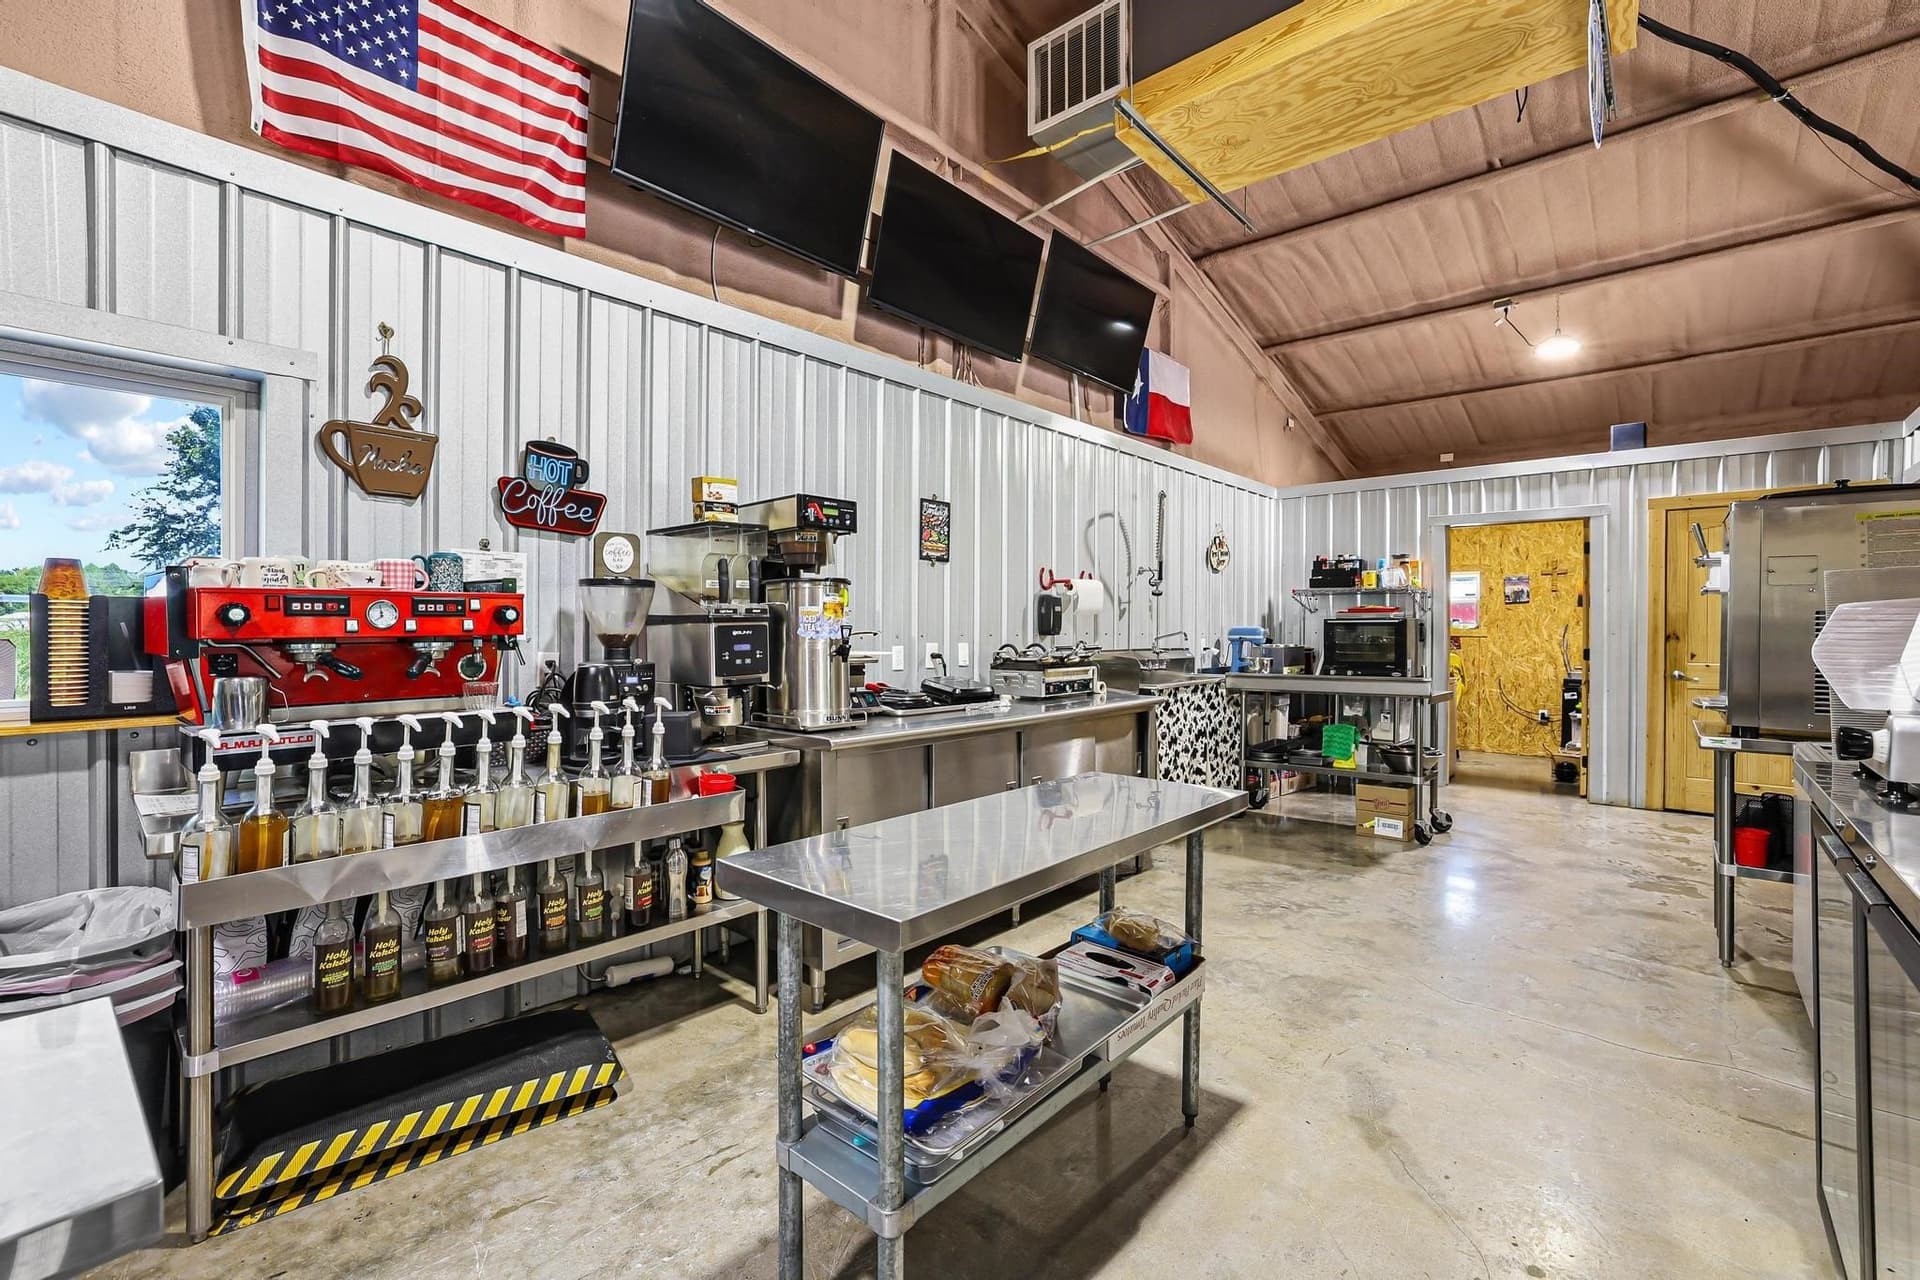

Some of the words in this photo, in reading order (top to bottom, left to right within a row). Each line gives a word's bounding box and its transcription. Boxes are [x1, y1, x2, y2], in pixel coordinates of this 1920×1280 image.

[359, 444, 425, 475] Mocha
[528, 454, 573, 486] HOT
[502, 479, 597, 527] Coffee
[804, 623, 816, 631] TEA
[587, 889, 603, 899] Holy
[548, 897, 566, 907] Holy
[474, 916, 493, 928] Holy
[428, 926, 448, 936] Holy
[374, 938, 397, 950] Holy
[325, 949, 349, 961] Holy
[1147, 998, 1172, 1021] Quality
